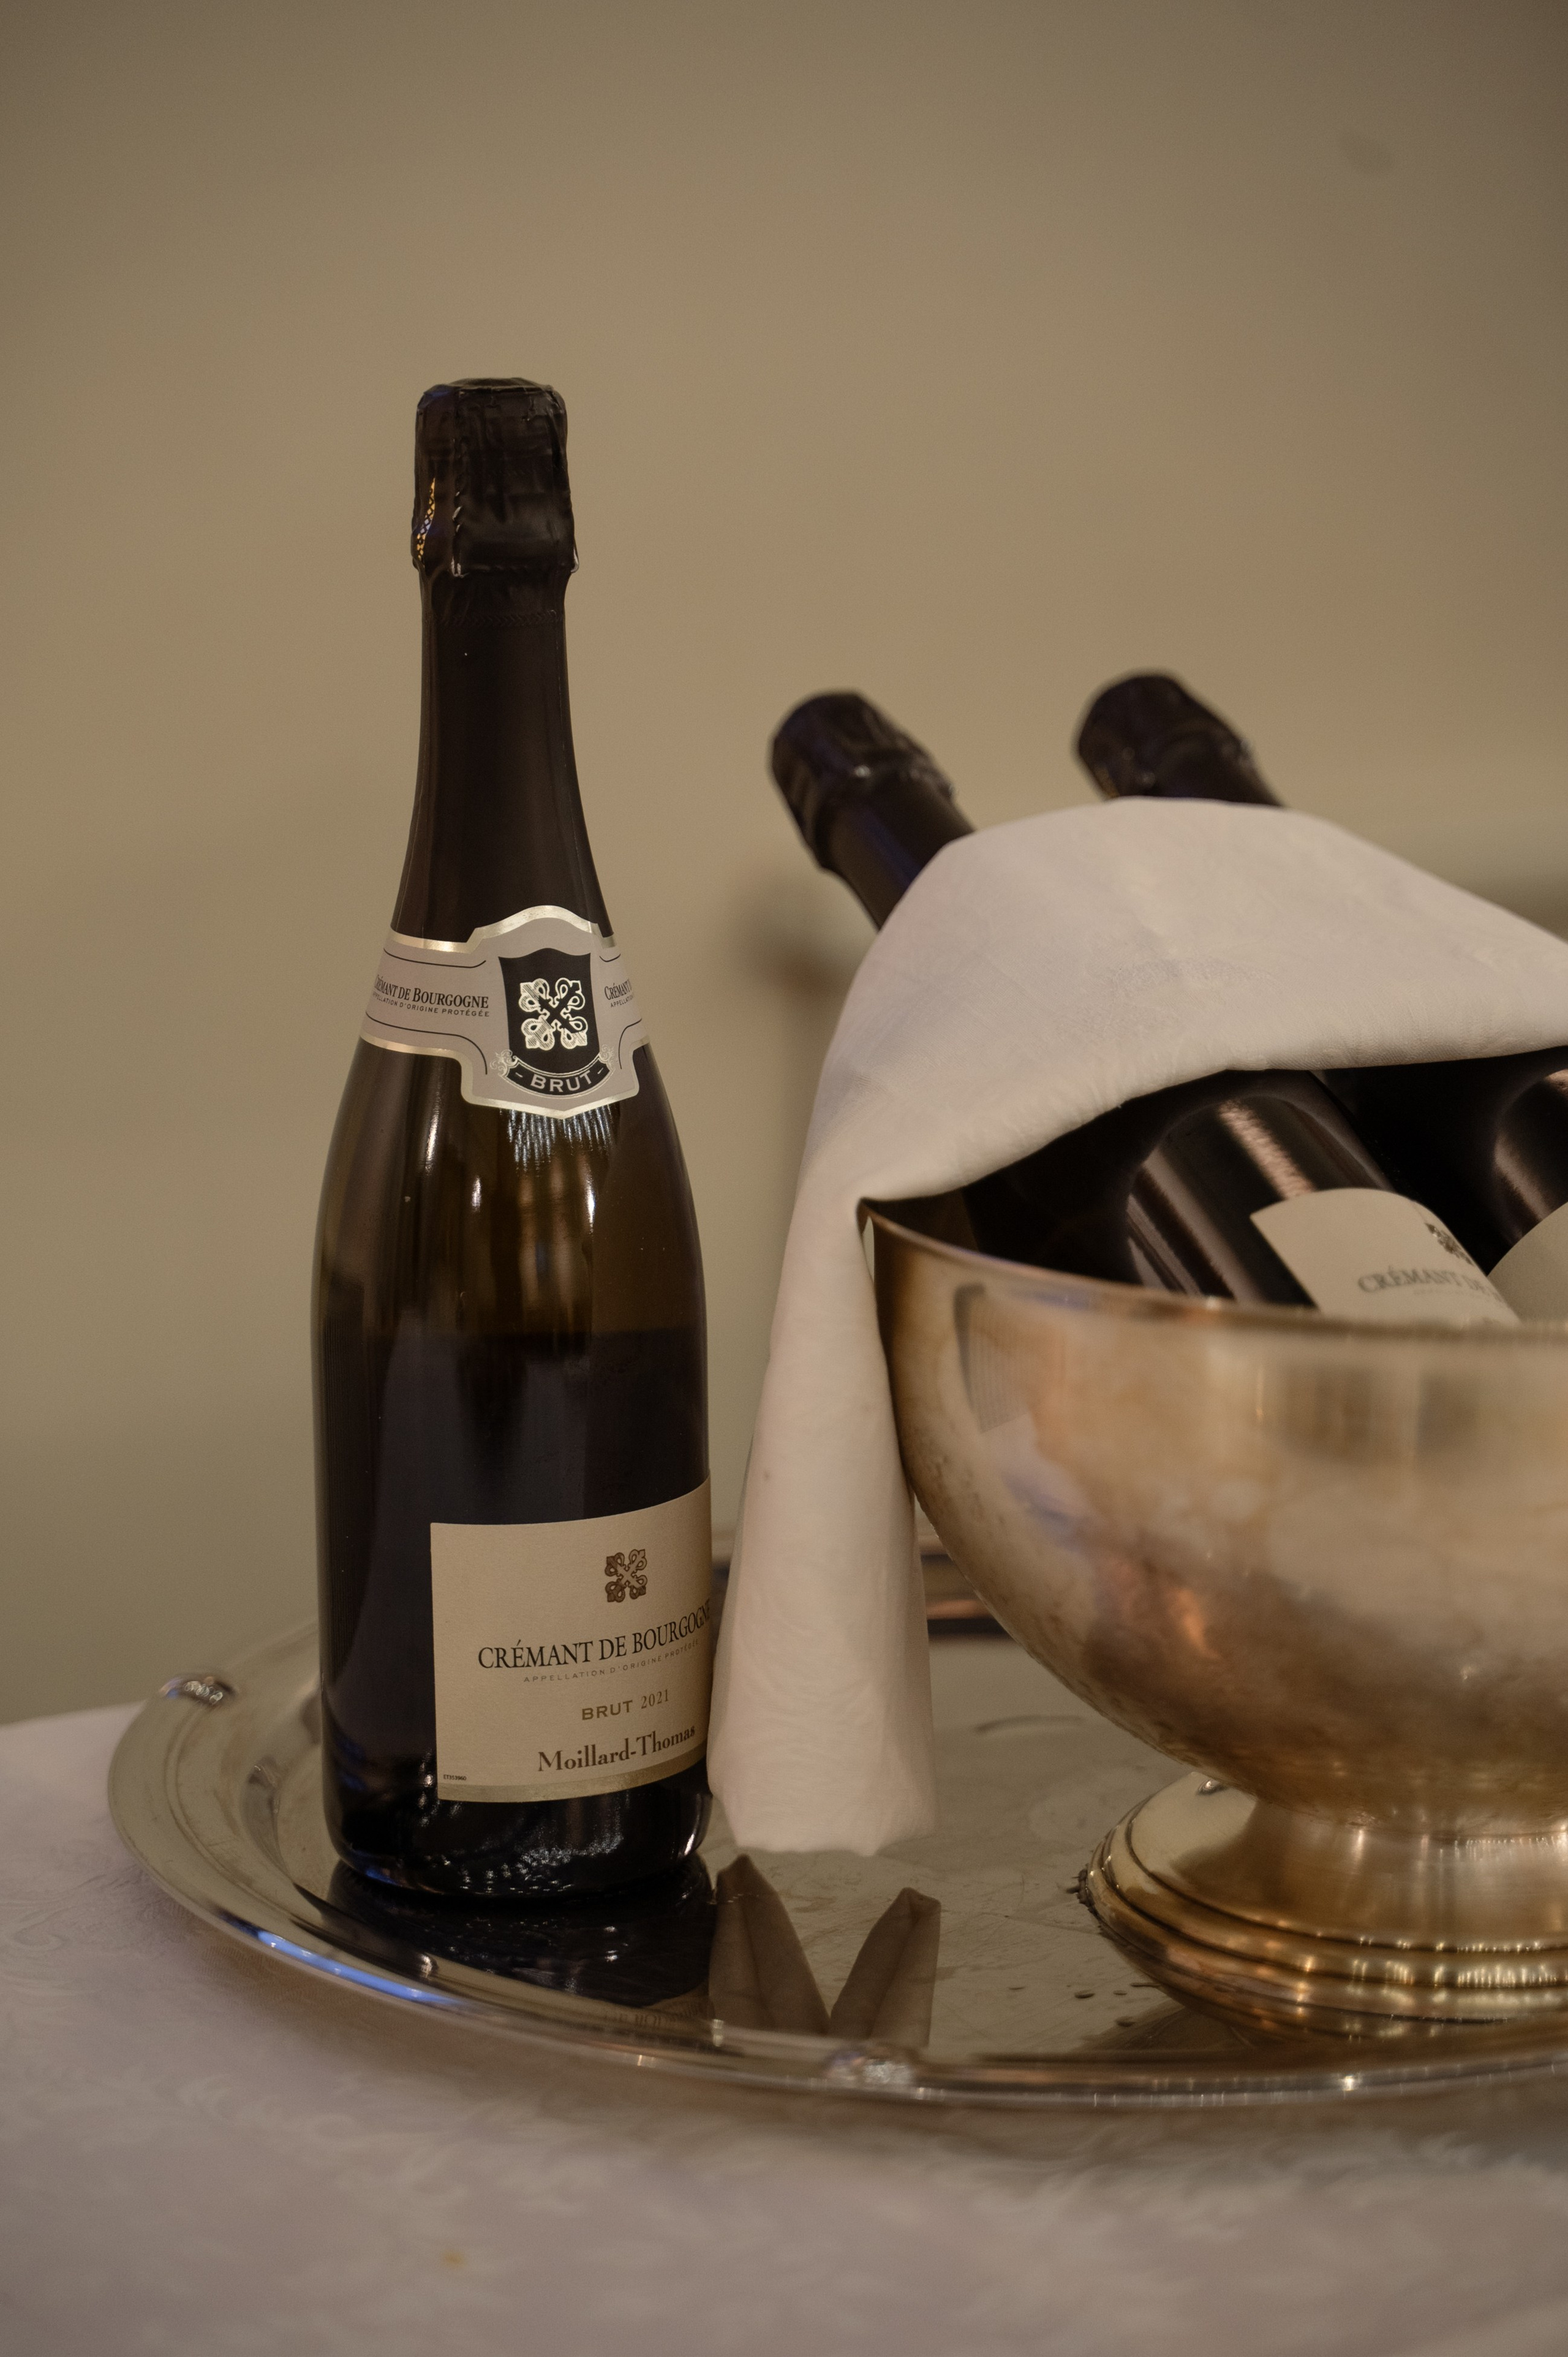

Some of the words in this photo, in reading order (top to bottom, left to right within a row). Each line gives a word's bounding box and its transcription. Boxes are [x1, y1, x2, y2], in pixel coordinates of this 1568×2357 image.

[398, 987, 411, 1001] DE
[412, 988, 489, 1008] BOURGOGNE
[399, 1002, 438, 1013] D'ORIGINE
[442, 1008, 489, 1017] PROTÉGÉE
[530, 1070, 592, 1092] BRUT
[478, 1640, 594, 1668] CRÉMANT
[599, 1635, 627, 1660] DE
[632, 1598, 710, 1654] BOURGOGNE
[524, 1669, 605, 1682] APPELLATION
[610, 1655, 662, 1673] D'ORIGINE
[582, 1700, 633, 1720] BRUT
[641, 1689, 669, 1709] 2021
[538, 1725, 696, 1772] Moillard-Thomas
